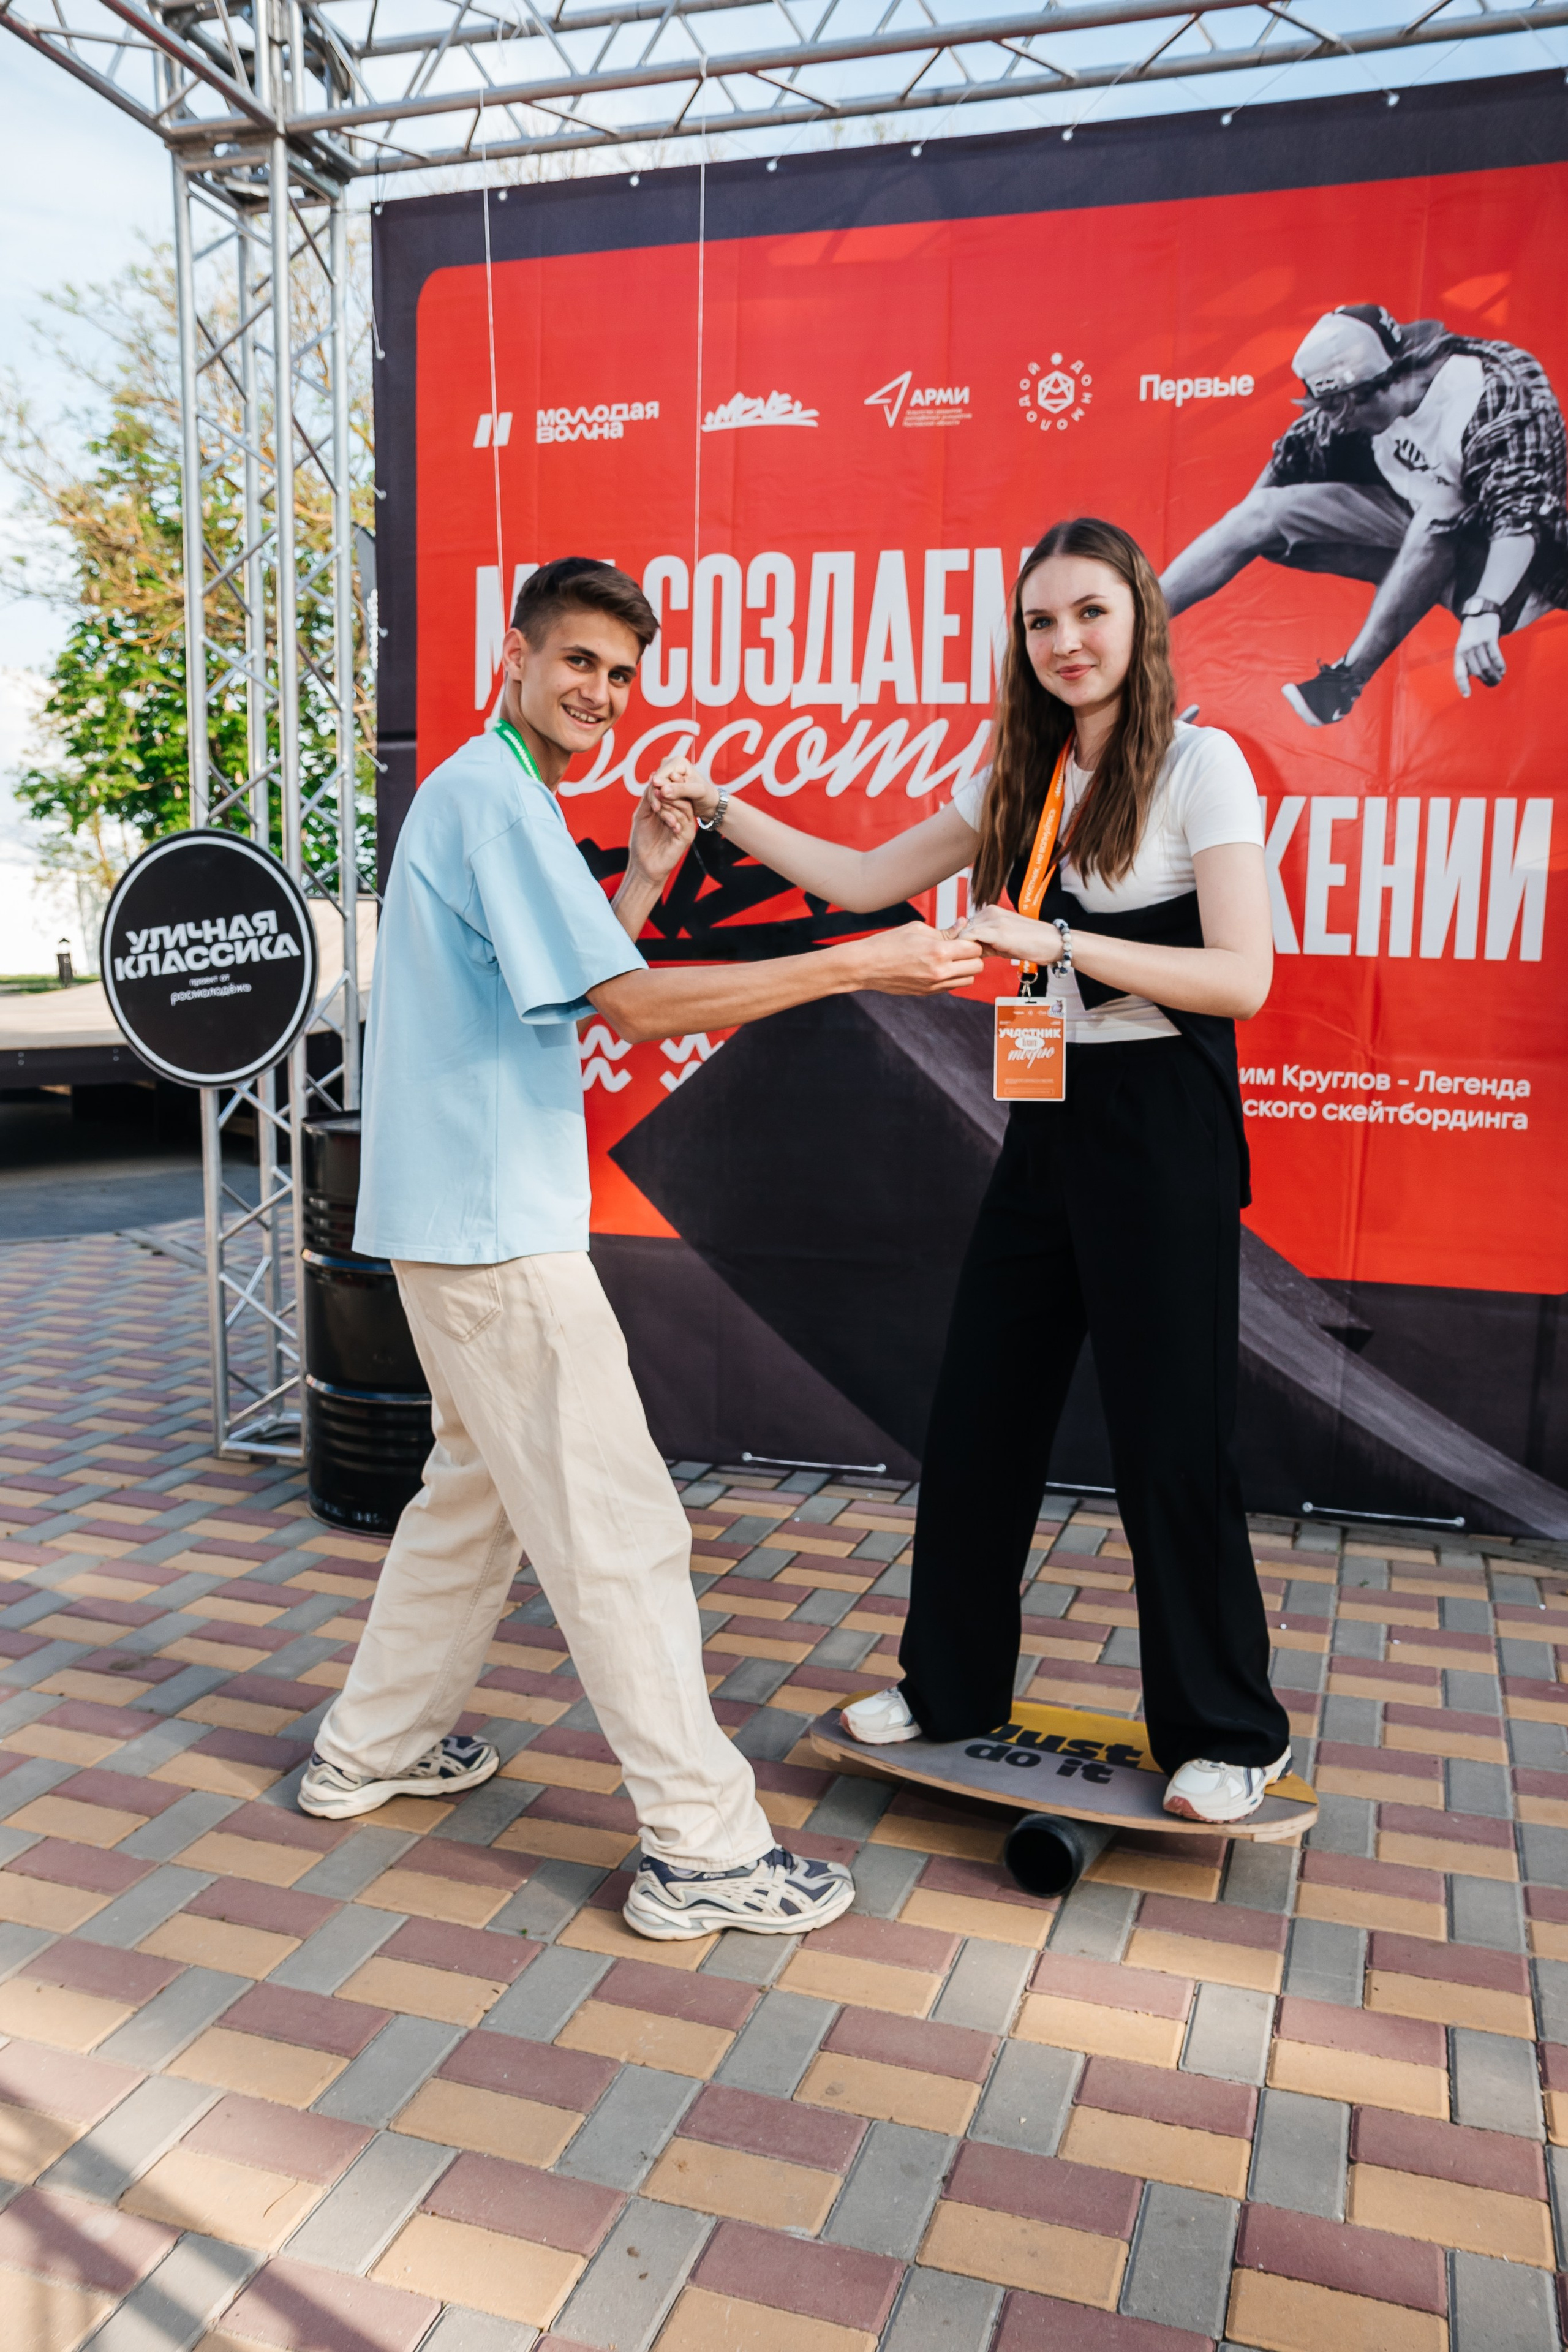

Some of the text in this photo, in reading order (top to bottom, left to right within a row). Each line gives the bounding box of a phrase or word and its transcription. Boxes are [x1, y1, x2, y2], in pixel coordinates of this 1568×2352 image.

[909, 386, 970, 407] АРМИ
[1139, 374, 1255, 408] Первые
[125, 909, 278, 955] УЛИЧНАЯ
[114, 933, 301, 981] КЛАССИКА
[998, 1028, 1061, 1039] УЧАСТНИК
[1282, 1064, 1391, 1093] Круглов
[1414, 1069, 1531, 1101] Легенда
[1321, 1100, 1529, 1132] скейтбординга
[965, 1743, 1114, 1784] do it
